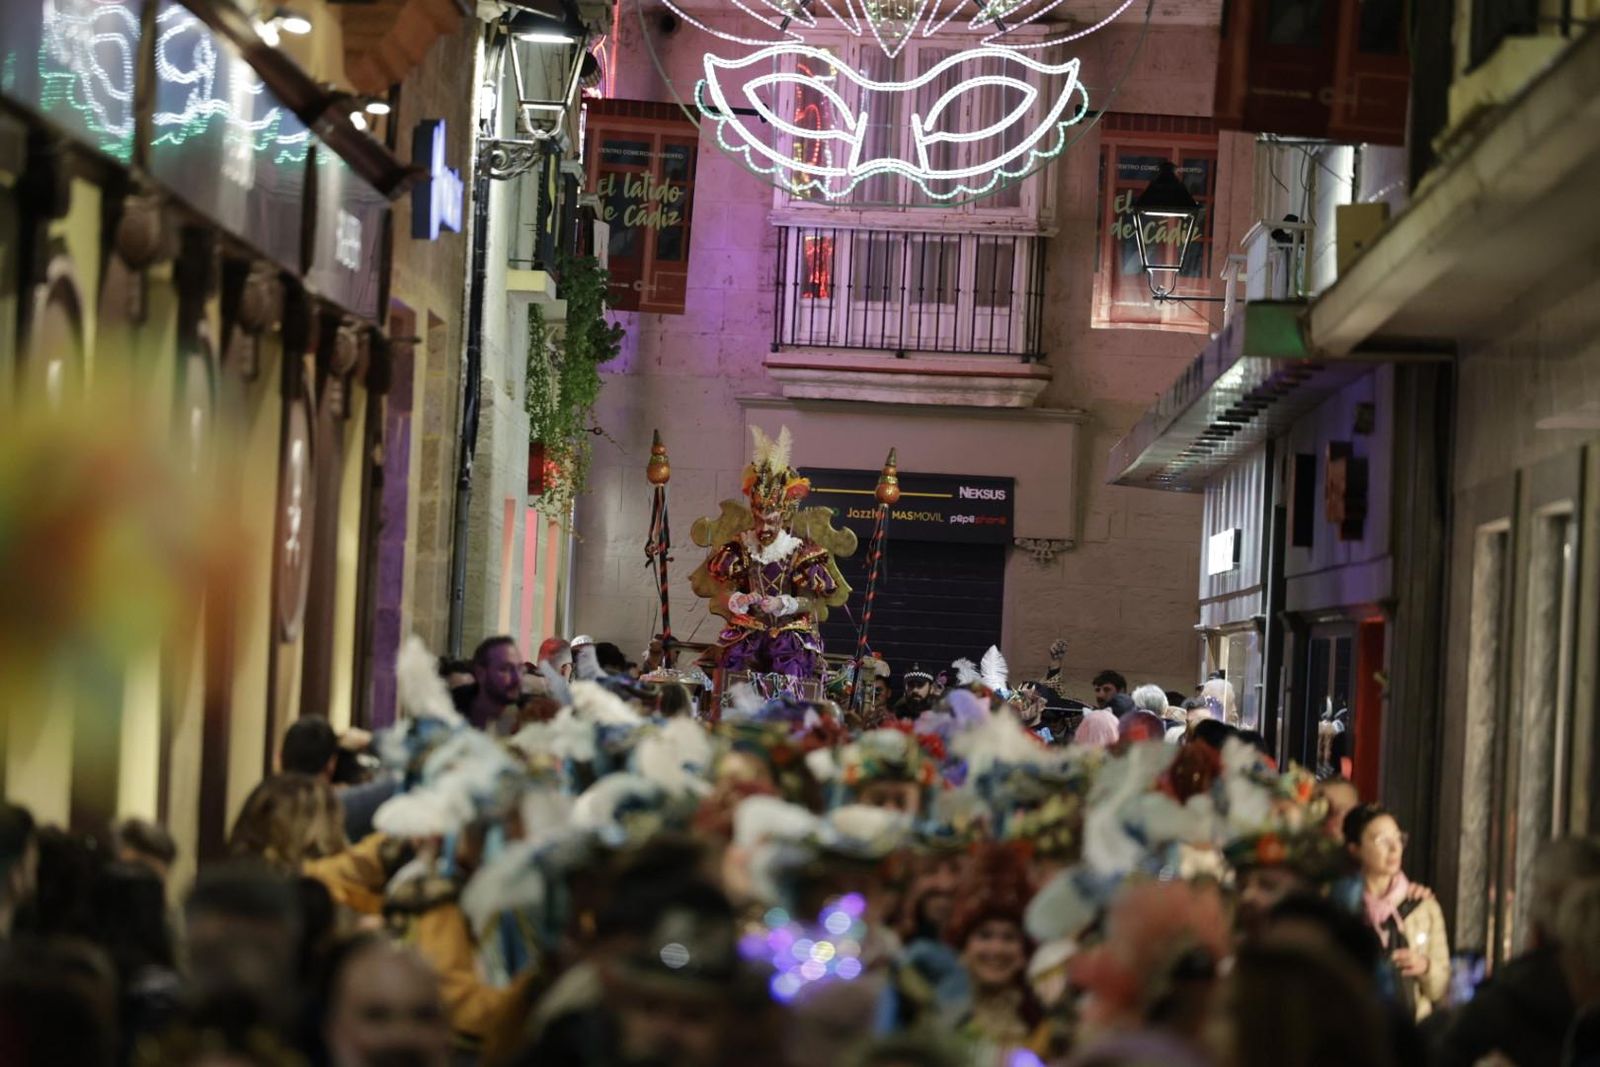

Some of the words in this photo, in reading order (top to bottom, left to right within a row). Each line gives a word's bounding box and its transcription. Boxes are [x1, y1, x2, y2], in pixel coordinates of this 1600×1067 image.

[597, 173, 617, 197] El
[624, 170, 684, 203] latido
[1113, 189, 1134, 214] El
[623, 203, 682, 230] Cádiz
[1109, 215, 1137, 240] de
[959, 485, 1006, 500] NEKSUS
[891, 510, 944, 523] MASMOVIL
